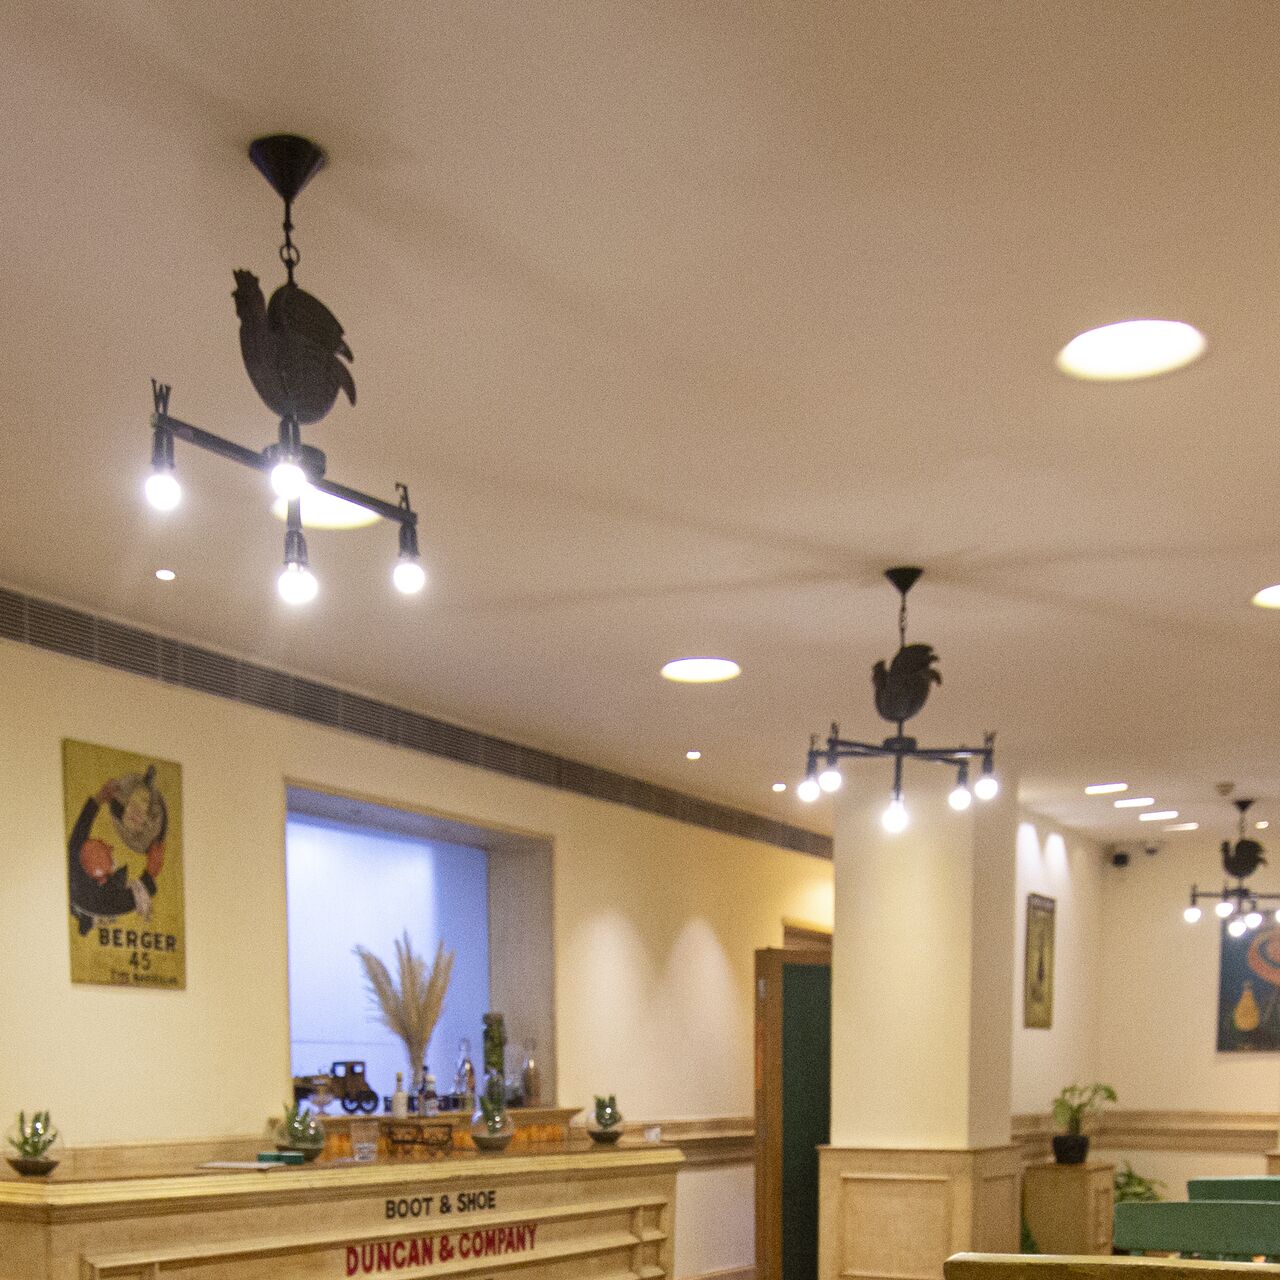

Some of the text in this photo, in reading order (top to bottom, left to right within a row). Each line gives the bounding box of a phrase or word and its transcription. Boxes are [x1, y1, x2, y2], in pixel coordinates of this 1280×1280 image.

[99, 927, 177, 952] BERGER
[129, 951, 151, 971] 45
[385, 1190, 497, 1219] BOOT & SHOE
[346, 1223, 538, 1277] DUNCAN & COMPANY
